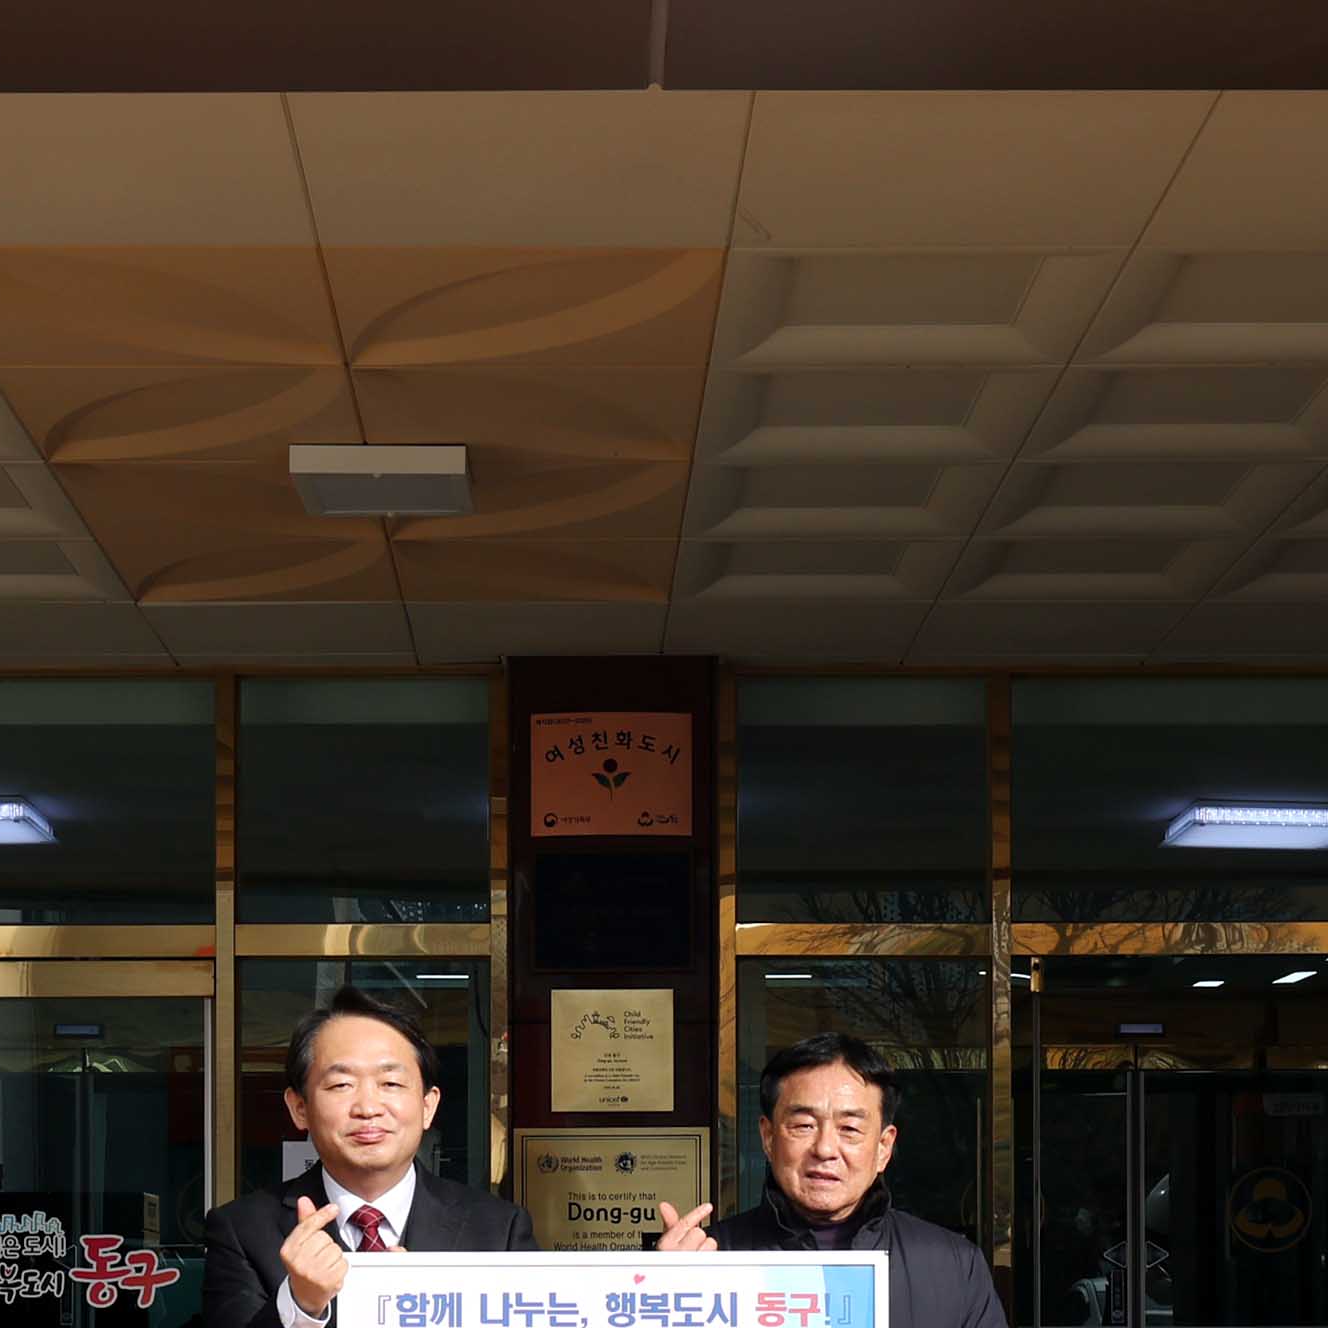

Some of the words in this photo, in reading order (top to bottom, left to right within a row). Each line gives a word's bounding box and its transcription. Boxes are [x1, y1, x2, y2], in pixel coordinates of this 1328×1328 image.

[545, 728, 681, 766] 여성친화도시
[624, 1019, 651, 1027] Friendly
[561, 1156, 580, 1164] World
[583, 1156, 602, 1164] Health
[561, 1164, 602, 1173] Organization
[569, 1192, 586, 1201] This
[589, 1192, 596, 1201] is
[598, 1193, 607, 1201] to
[609, 1192, 636, 1202] certify
[639, 1193, 656, 1201] that
[569, 1202, 655, 1224] Dong-gu
[574, 1232, 580, 1240] is
[591, 1232, 624, 1240] member
[627, 1232, 636, 1240] of
[23, 1236, 66, 1258] 도시!
[69, 1234, 180, 1308] 동구
[605, 1291, 739, 1328] 행복도시
